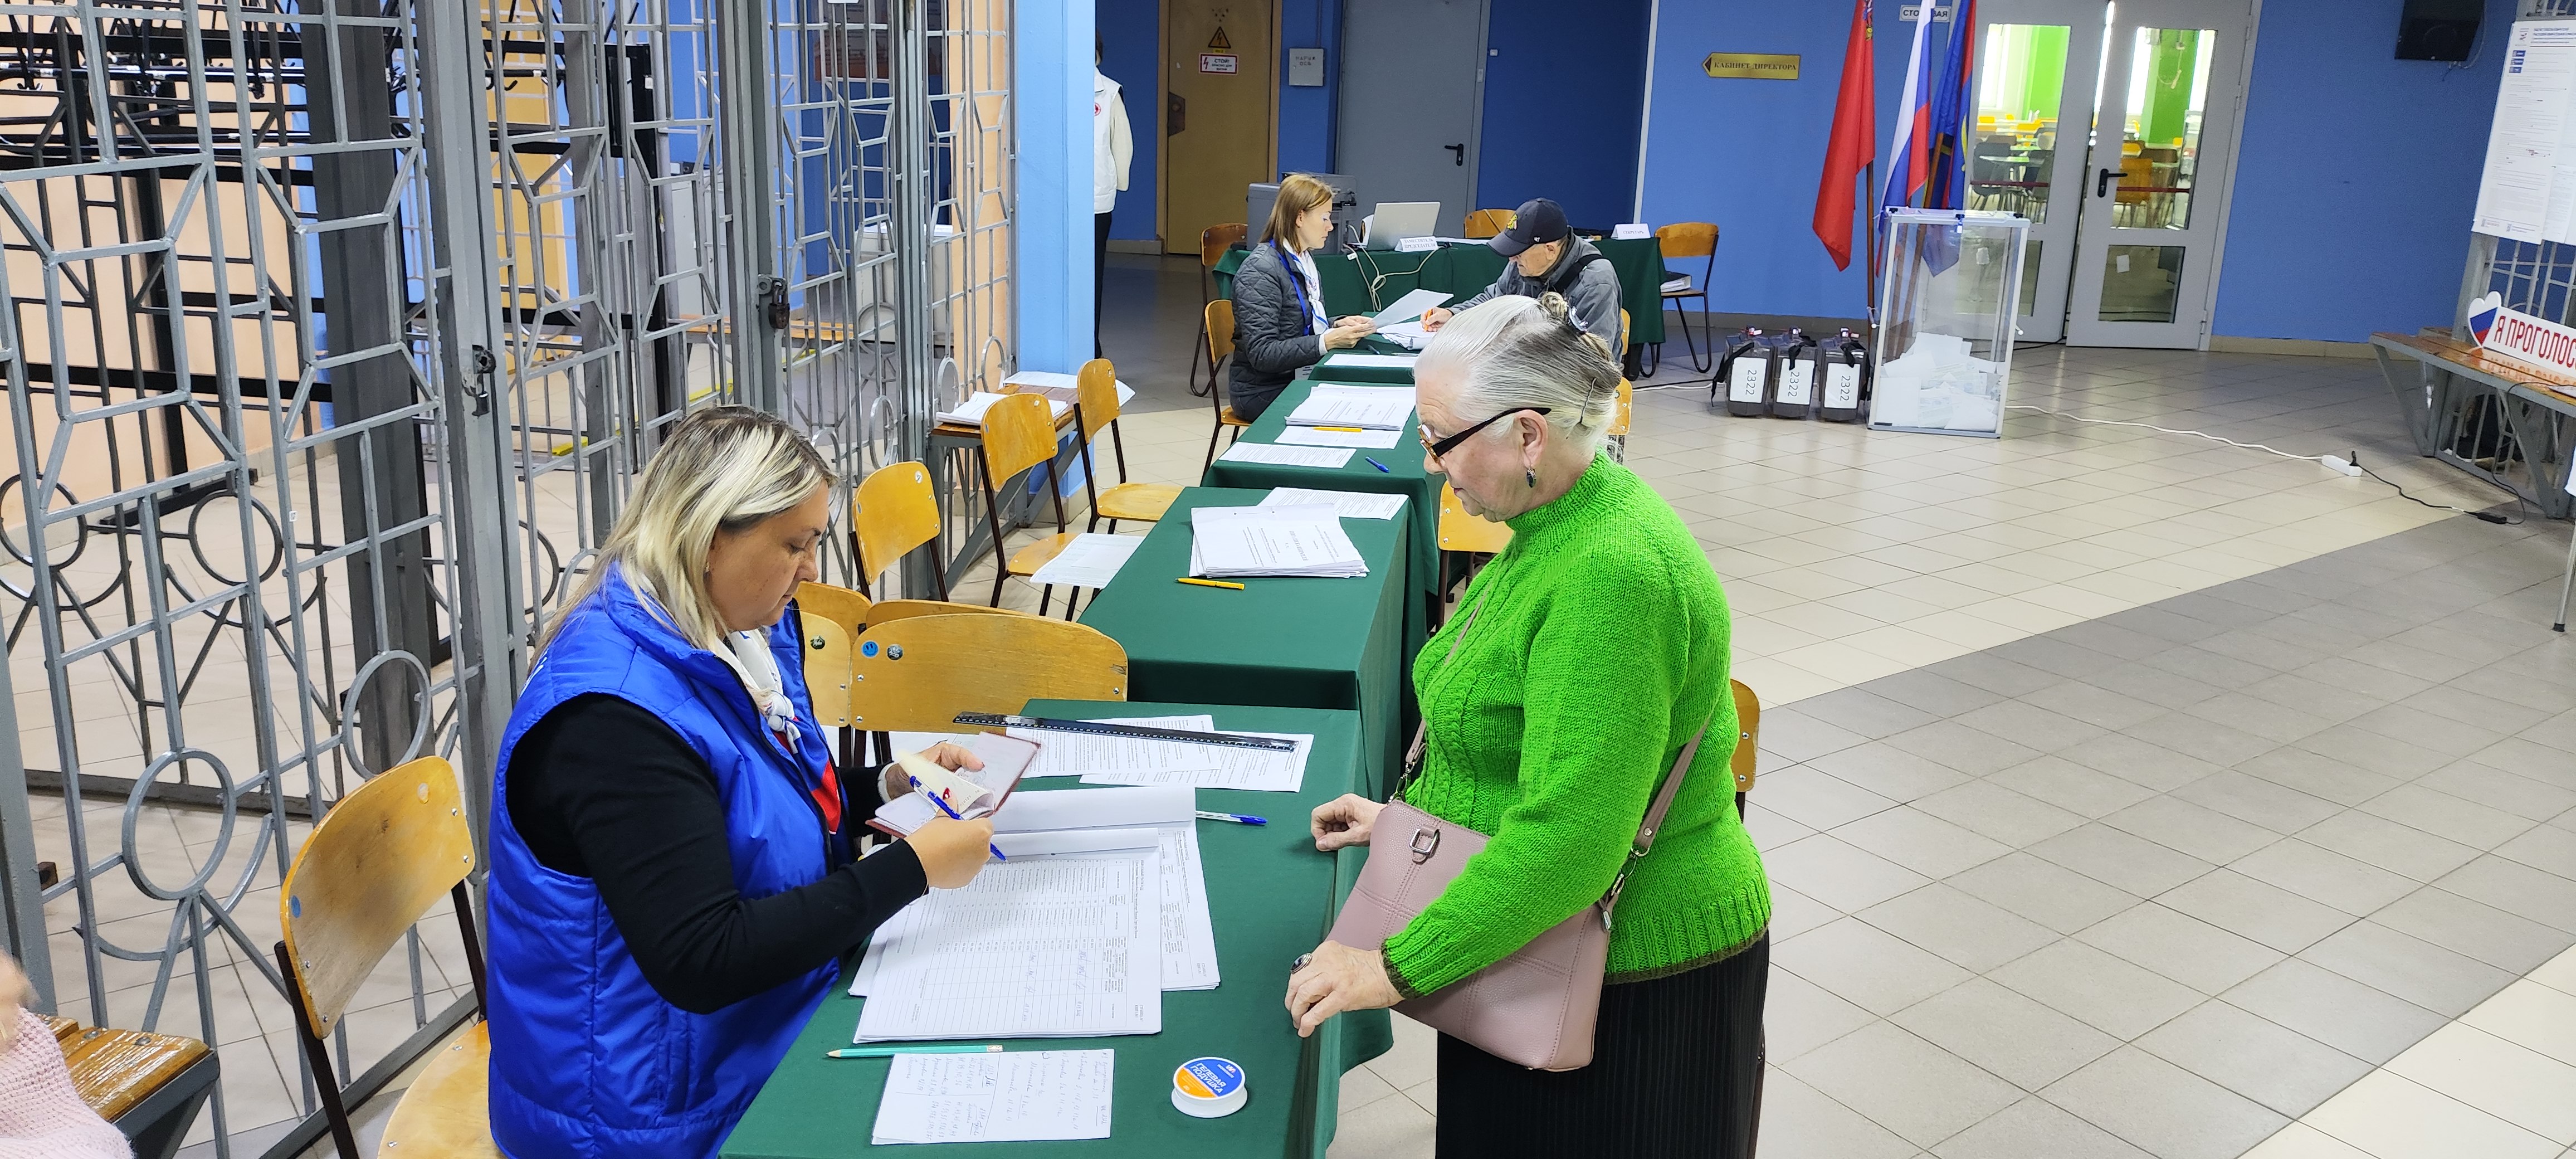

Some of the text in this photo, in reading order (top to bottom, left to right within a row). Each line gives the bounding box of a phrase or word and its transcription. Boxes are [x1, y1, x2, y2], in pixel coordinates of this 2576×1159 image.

[2494, 315, 2576, 370] Я ПРОГОЛОС
[1745, 369, 1757, 396] 2322
[1788, 371, 1800, 397] 2322
[1840, 375, 1851, 402] 2322
[1189, 1065, 1223, 1093] ПОДУШКА
[1196, 1063, 1227, 1087] ГЕЛЕВАЯ
